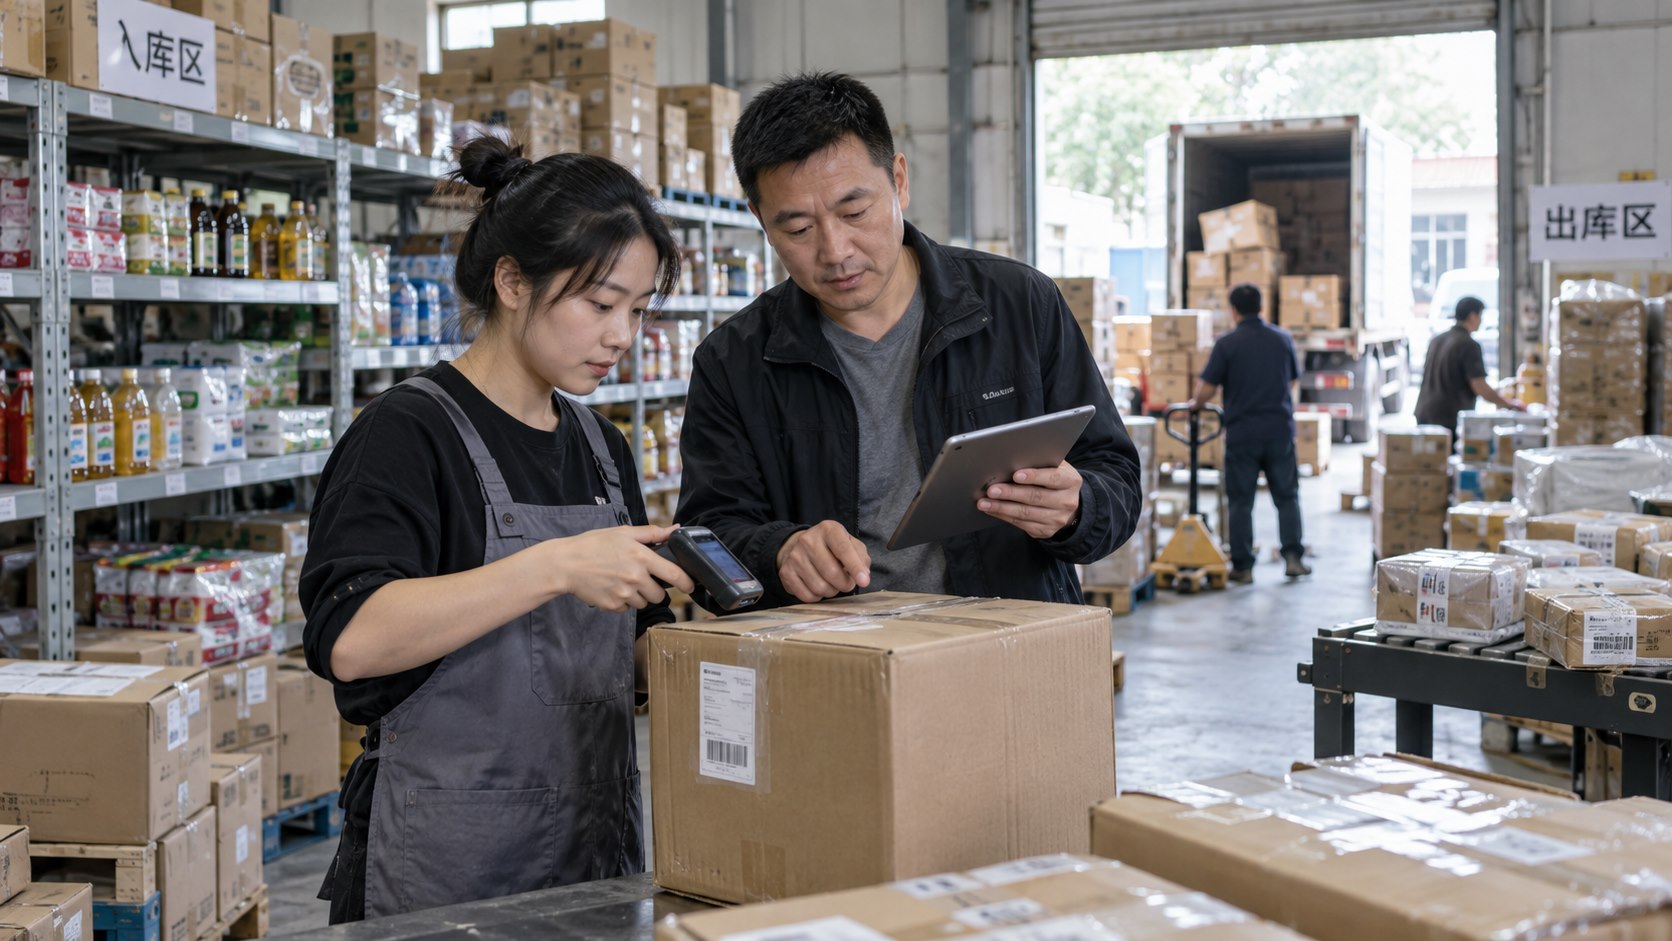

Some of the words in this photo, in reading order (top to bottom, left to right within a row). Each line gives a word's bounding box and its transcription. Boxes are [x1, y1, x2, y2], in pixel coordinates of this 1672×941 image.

[118, 19, 205, 85] 入库区
[1545, 203, 1656, 240] 出库区
